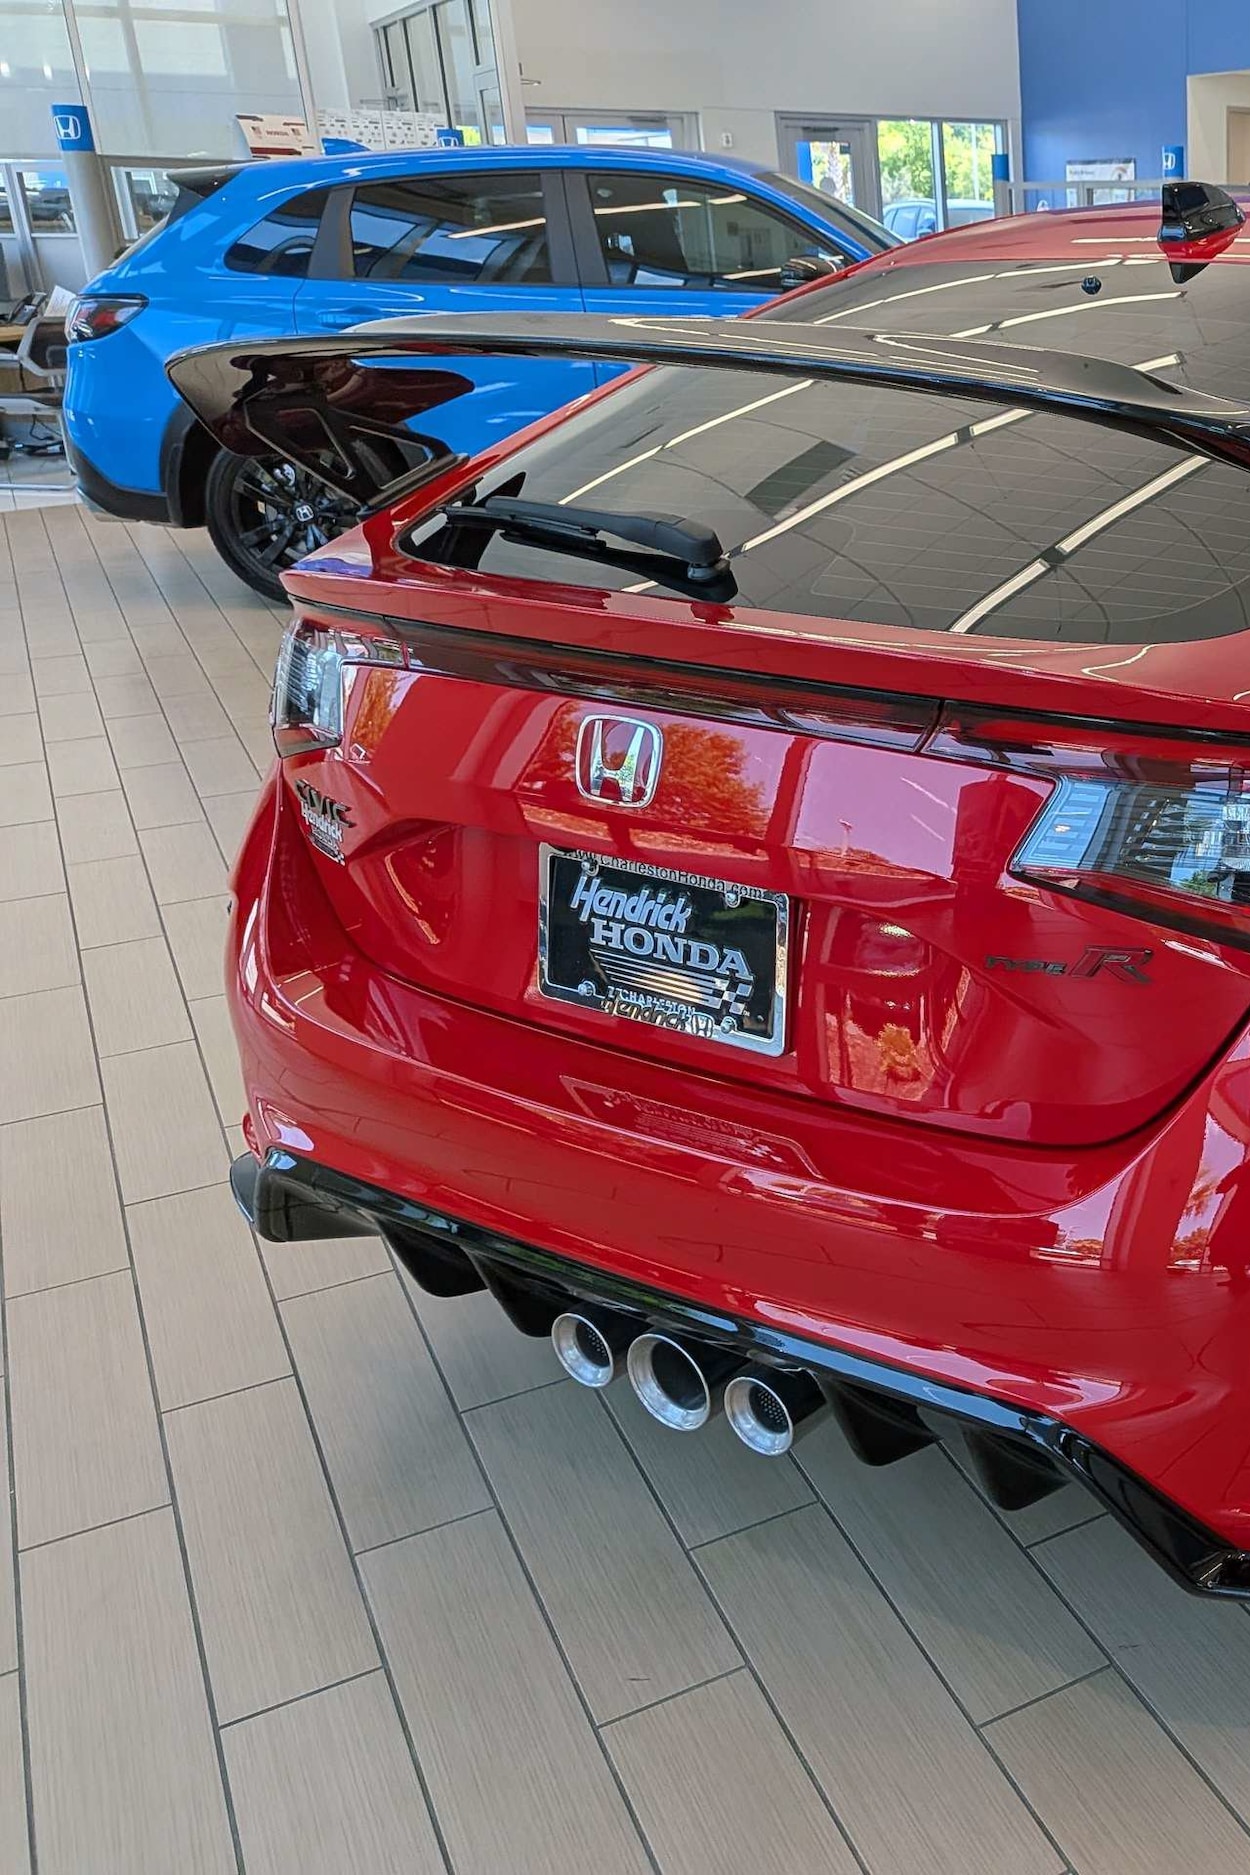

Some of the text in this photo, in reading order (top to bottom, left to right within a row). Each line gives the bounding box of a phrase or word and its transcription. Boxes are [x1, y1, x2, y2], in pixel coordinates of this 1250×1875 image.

[570, 876, 692, 934] Hendrick
[589, 917, 754, 981] HONDA
[1068, 945, 1153, 984] R
